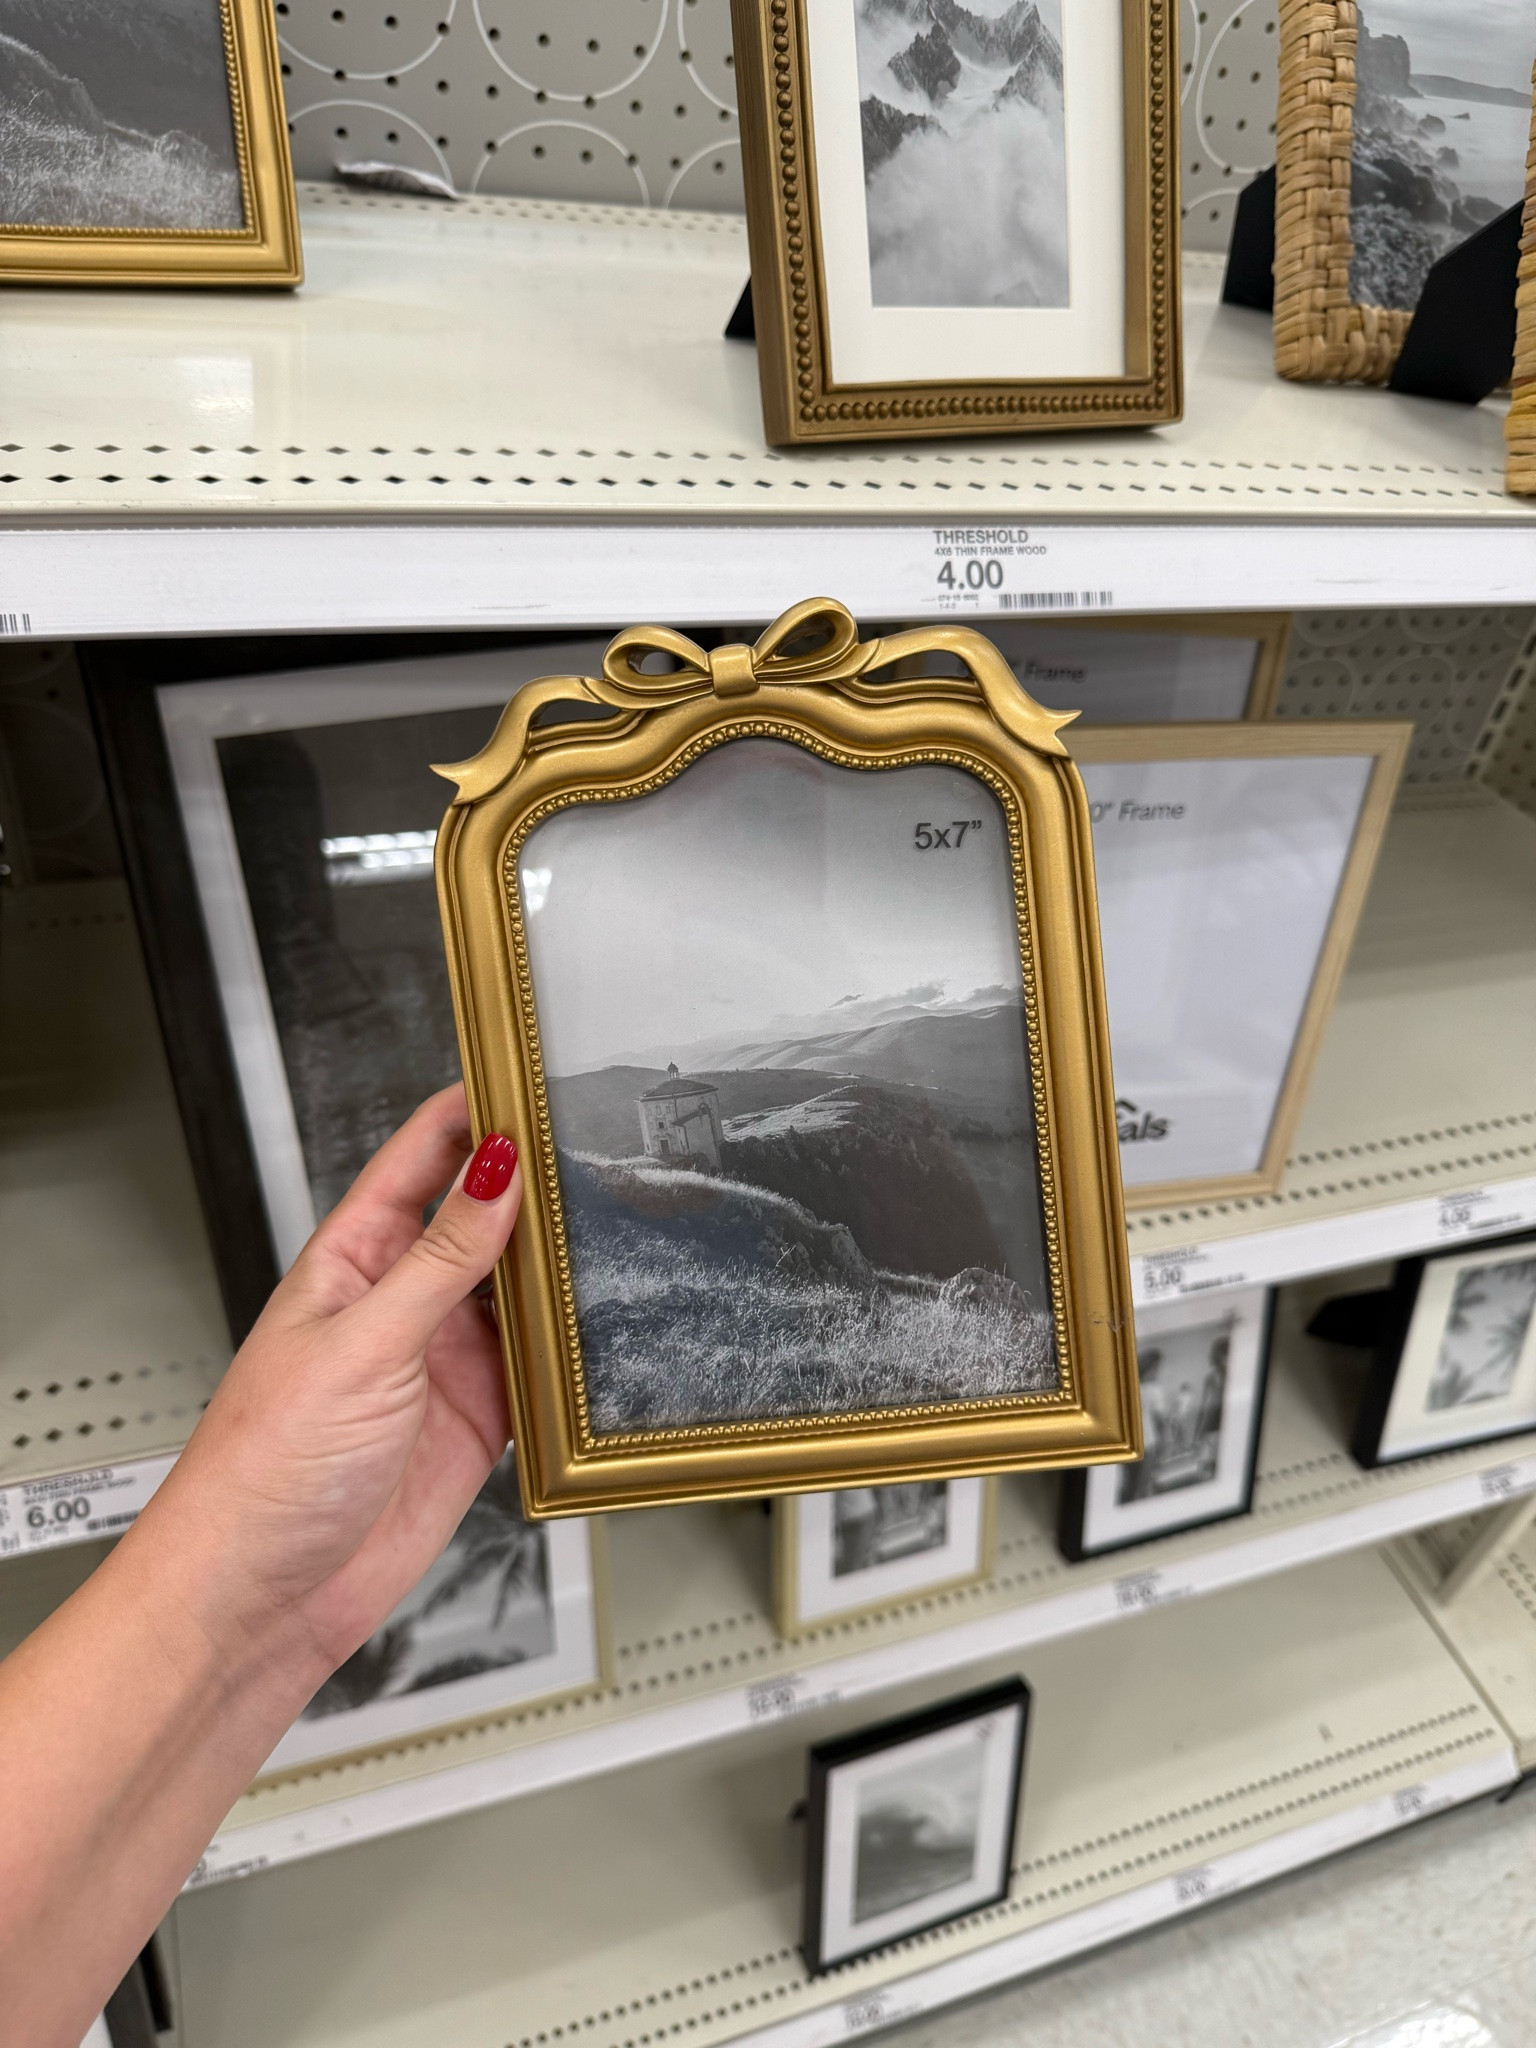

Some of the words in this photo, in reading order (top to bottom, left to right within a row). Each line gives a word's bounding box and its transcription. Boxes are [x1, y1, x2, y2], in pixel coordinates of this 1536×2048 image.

[933, 529, 1029, 544] THRESHOLD
[955, 547, 978, 556] THIN
[980, 547, 1014, 556] FRAME
[1016, 546, 1047, 555] WOOD
[937, 560, 1004, 590] 4.00
[1118, 800, 1186, 822] Frame
[27, 1496, 91, 1529] 6.00
